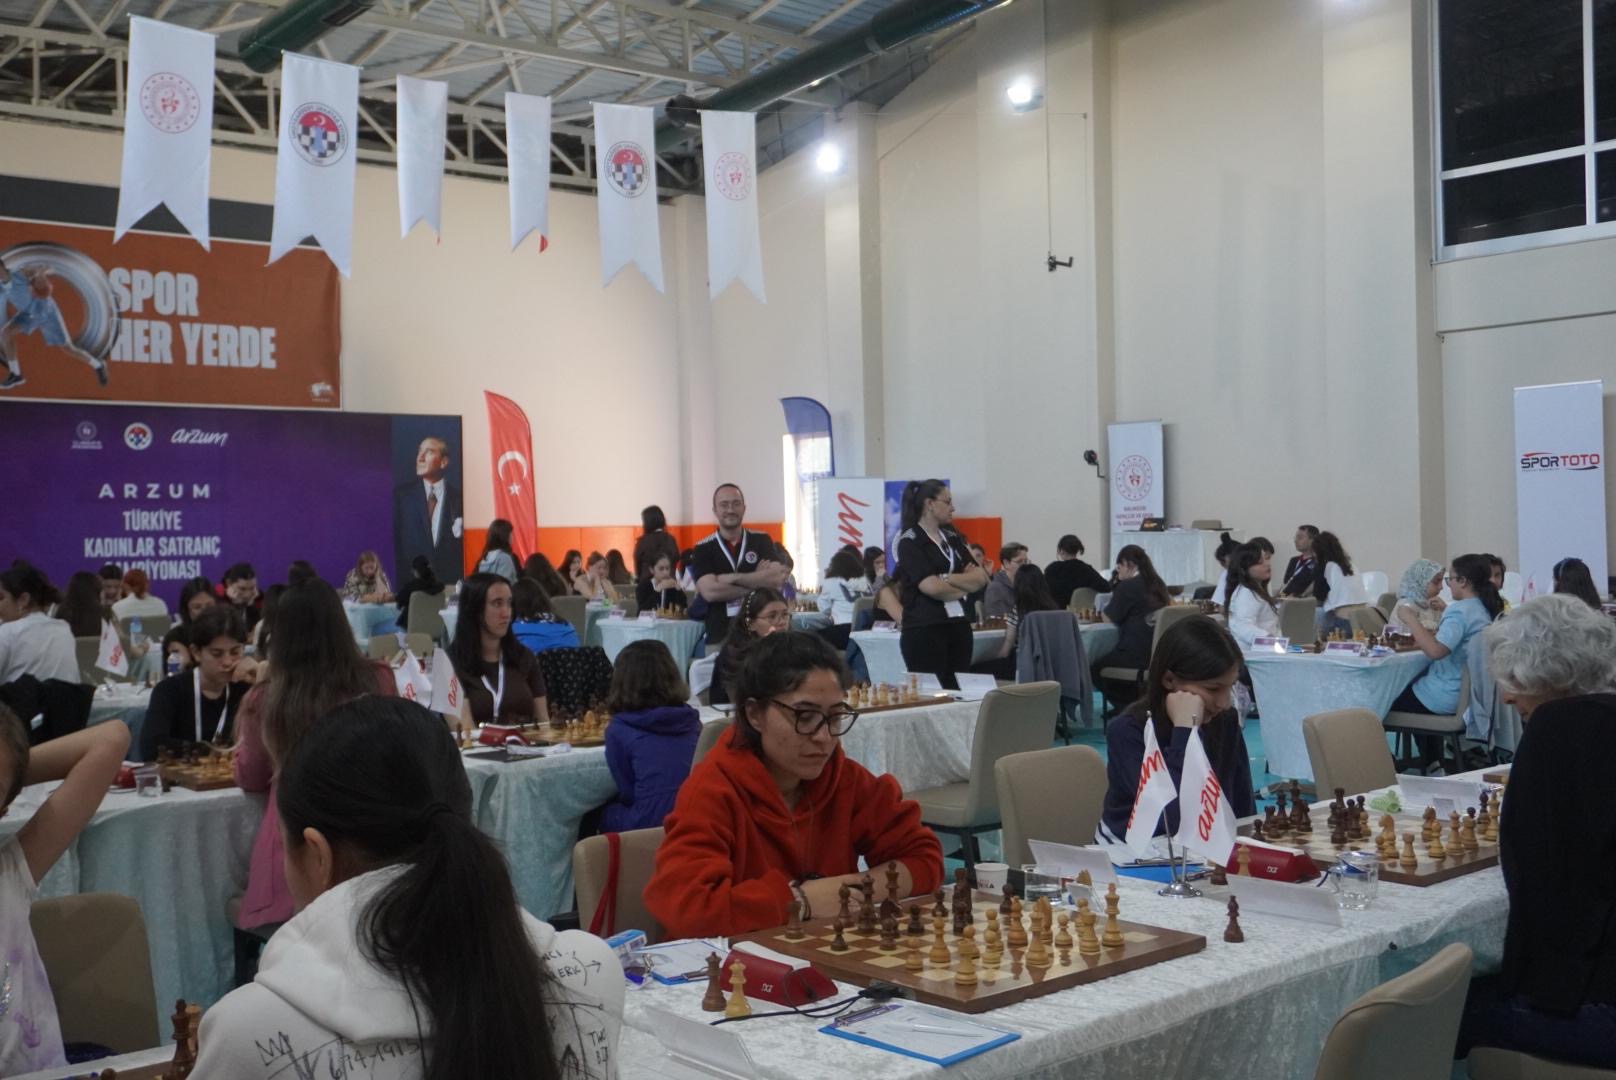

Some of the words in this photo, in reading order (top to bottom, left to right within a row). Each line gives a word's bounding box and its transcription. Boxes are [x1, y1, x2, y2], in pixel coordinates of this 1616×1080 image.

[109, 267, 199, 316] SPOR
[110, 318, 173, 364] HER
[180, 322, 277, 369] YERDE
[170, 428, 229, 447] arzum
[99, 483, 210, 498] ARZUM
[122, 508, 183, 531] TÜRKİYE
[84, 537, 155, 558] KADINLAR
[158, 535, 221, 558] SATRANÇ
[104, 558, 201, 580] MPİYONASI
[1198, 769, 1221, 842] arzu
